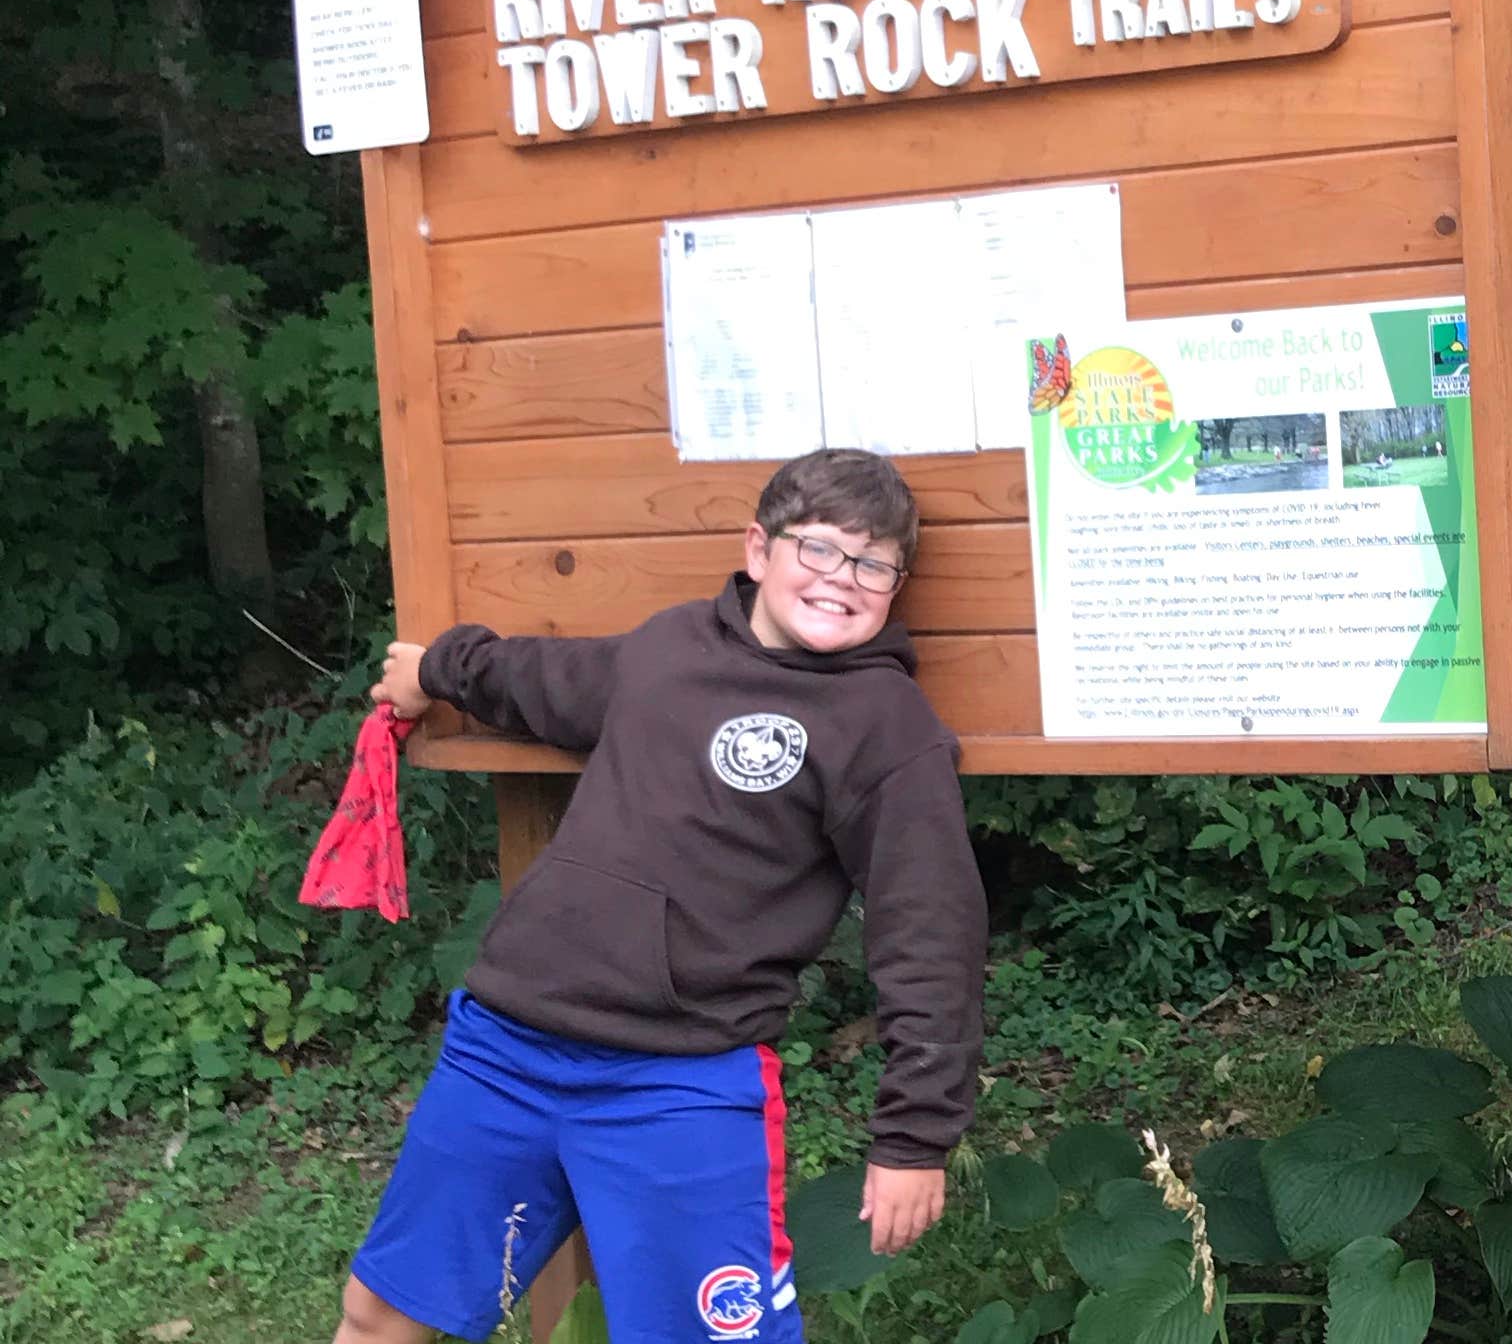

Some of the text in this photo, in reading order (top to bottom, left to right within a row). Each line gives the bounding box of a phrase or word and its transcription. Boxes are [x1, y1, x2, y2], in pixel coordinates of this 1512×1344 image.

[498, 18, 766, 136] TOWER
[1429, 314, 1464, 323] ILLINO
[1176, 328, 1363, 362] Welcome Back to
[1088, 373, 1141, 388] Illinois
[1255, 361, 1365, 397] our Parks!
[1075, 388, 1152, 406] STATE
[1078, 407, 1155, 424] PARKS
[1077, 427, 1156, 446] GREAT
[1079, 445, 1158, 464] PARKS
